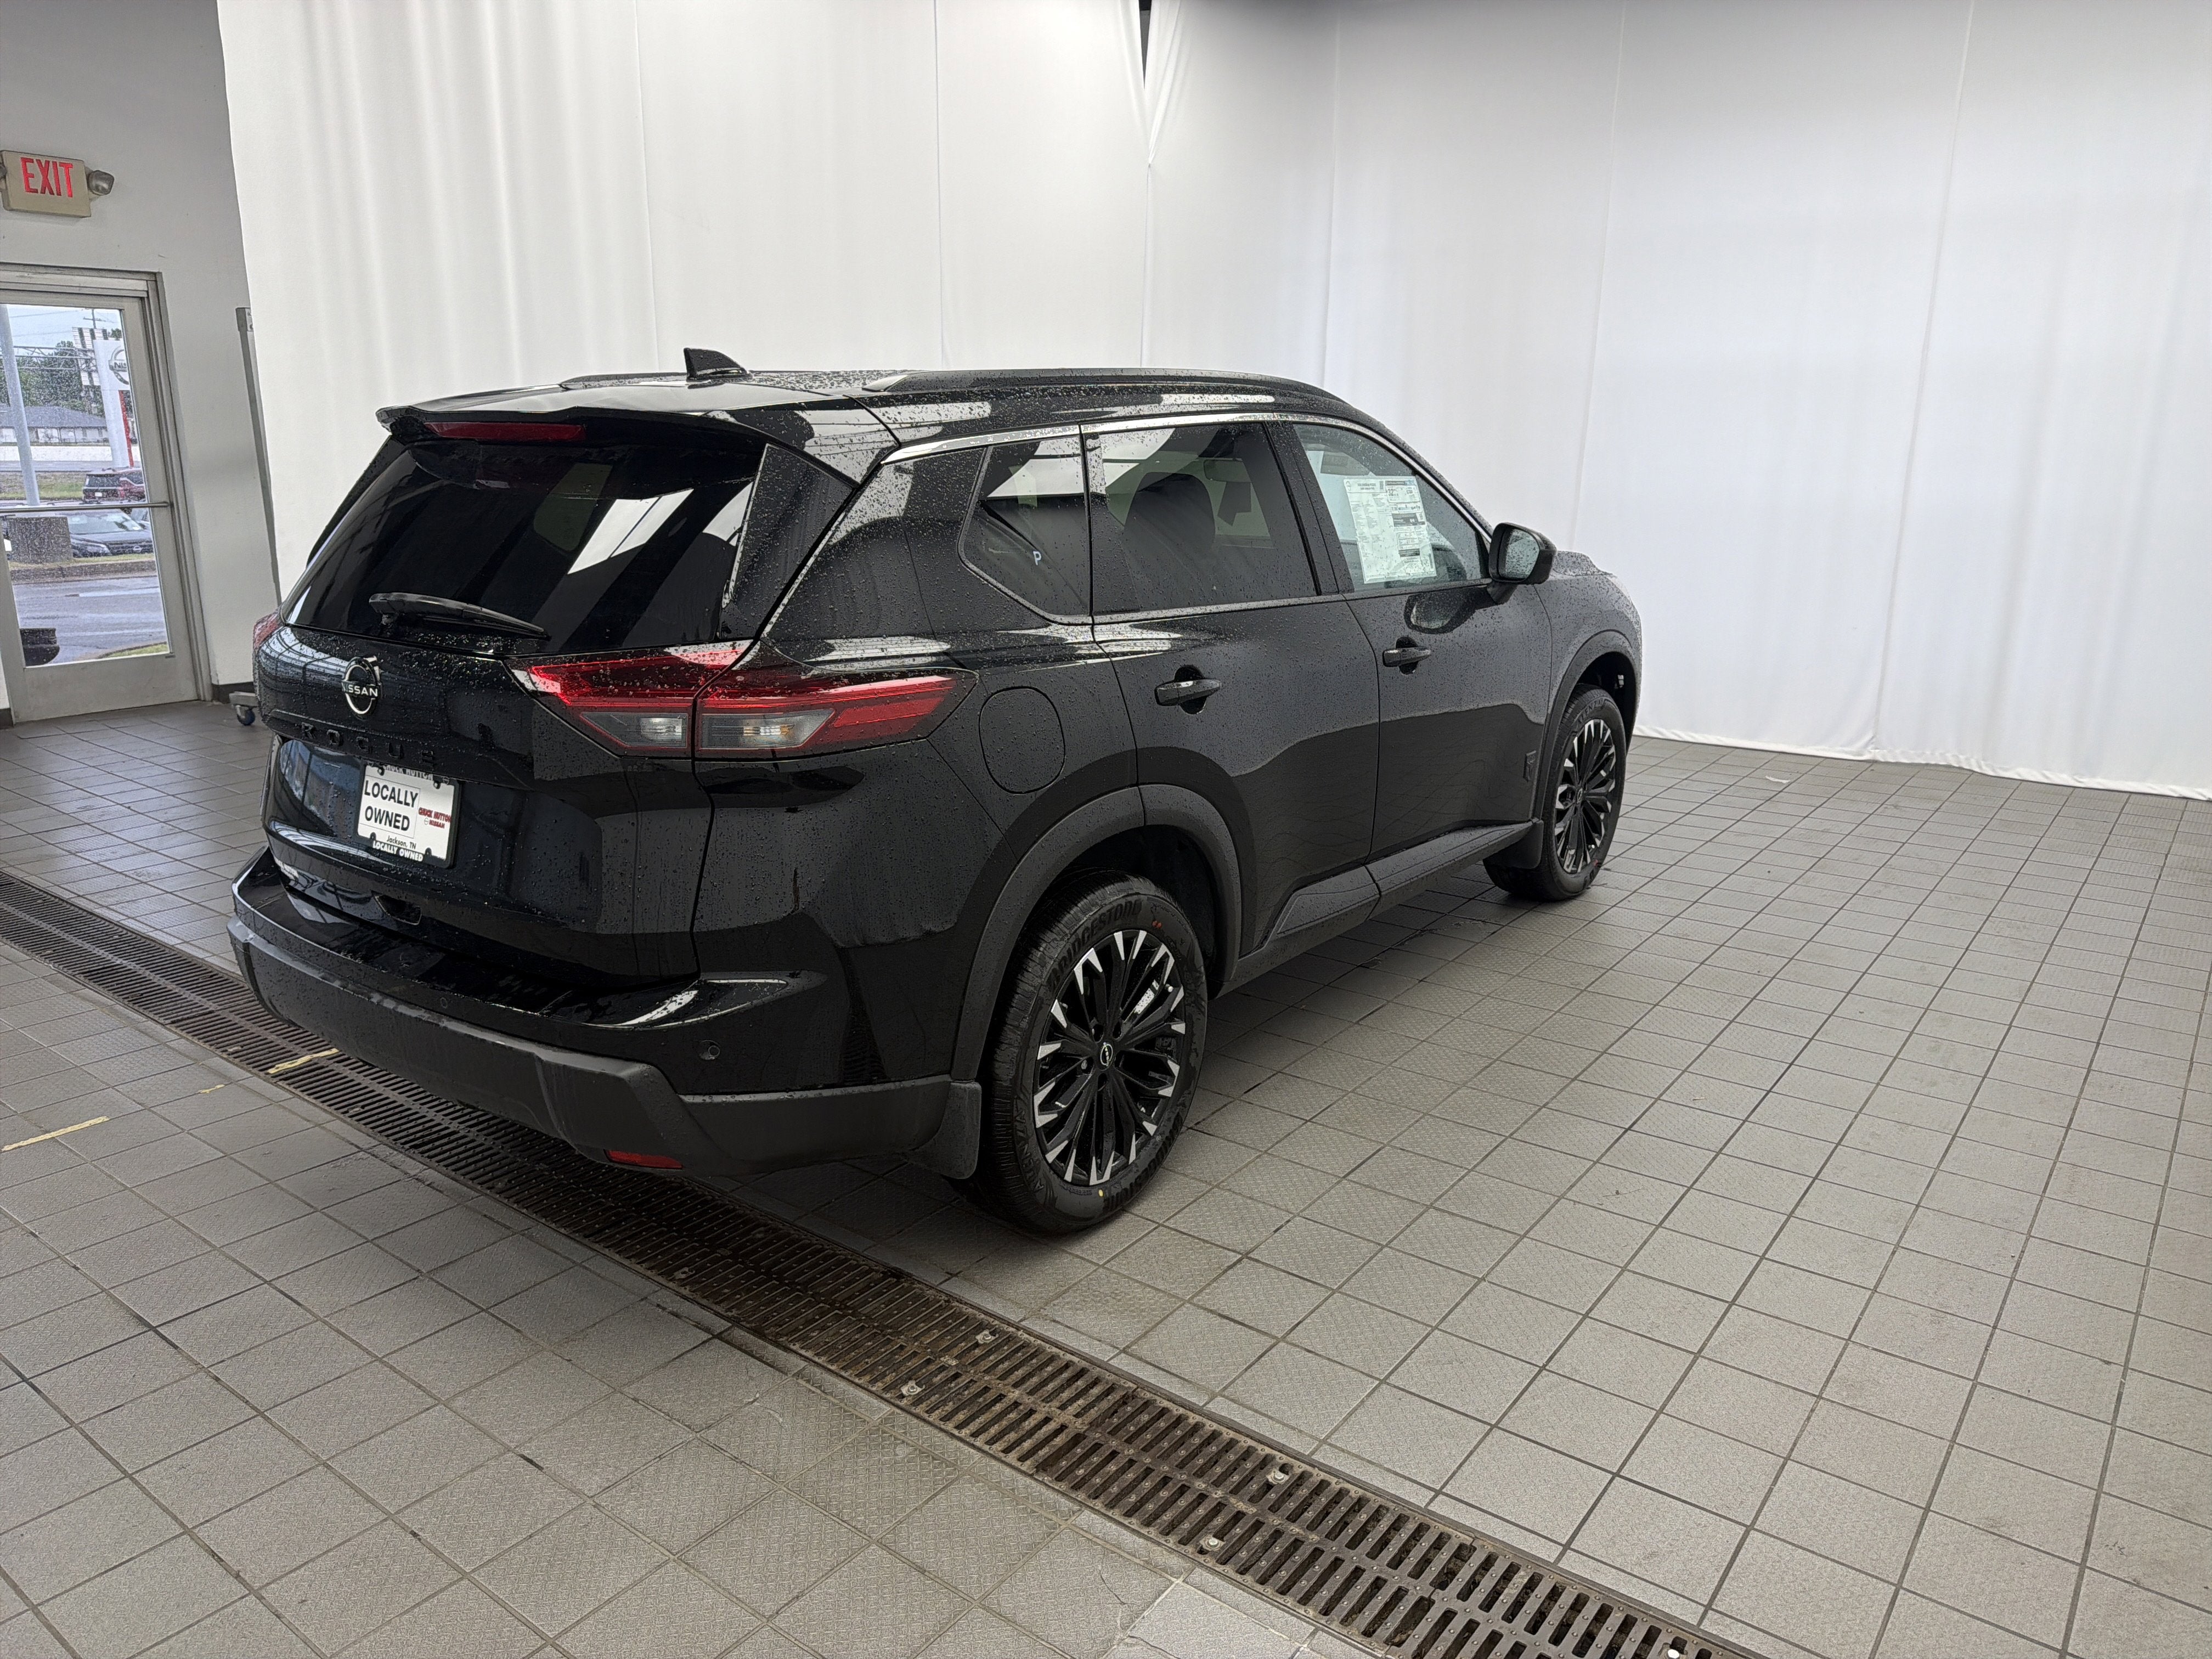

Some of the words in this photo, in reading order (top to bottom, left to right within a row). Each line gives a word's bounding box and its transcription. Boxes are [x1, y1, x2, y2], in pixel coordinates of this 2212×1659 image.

[20, 157, 73, 198] EXIT
[341, 682, 378, 697] NISSAN
[301, 721, 435, 766] ROGUE
[364, 780, 418, 808] LOCALLY
[365, 805, 410, 831] OWNED
[418, 807, 433, 818] CHUCK
[373, 840, 399, 855] LOCALLY
[399, 848, 424, 862] OWNED
[386, 836, 408, 847] Jackson,
[409, 842, 416, 850] TN
